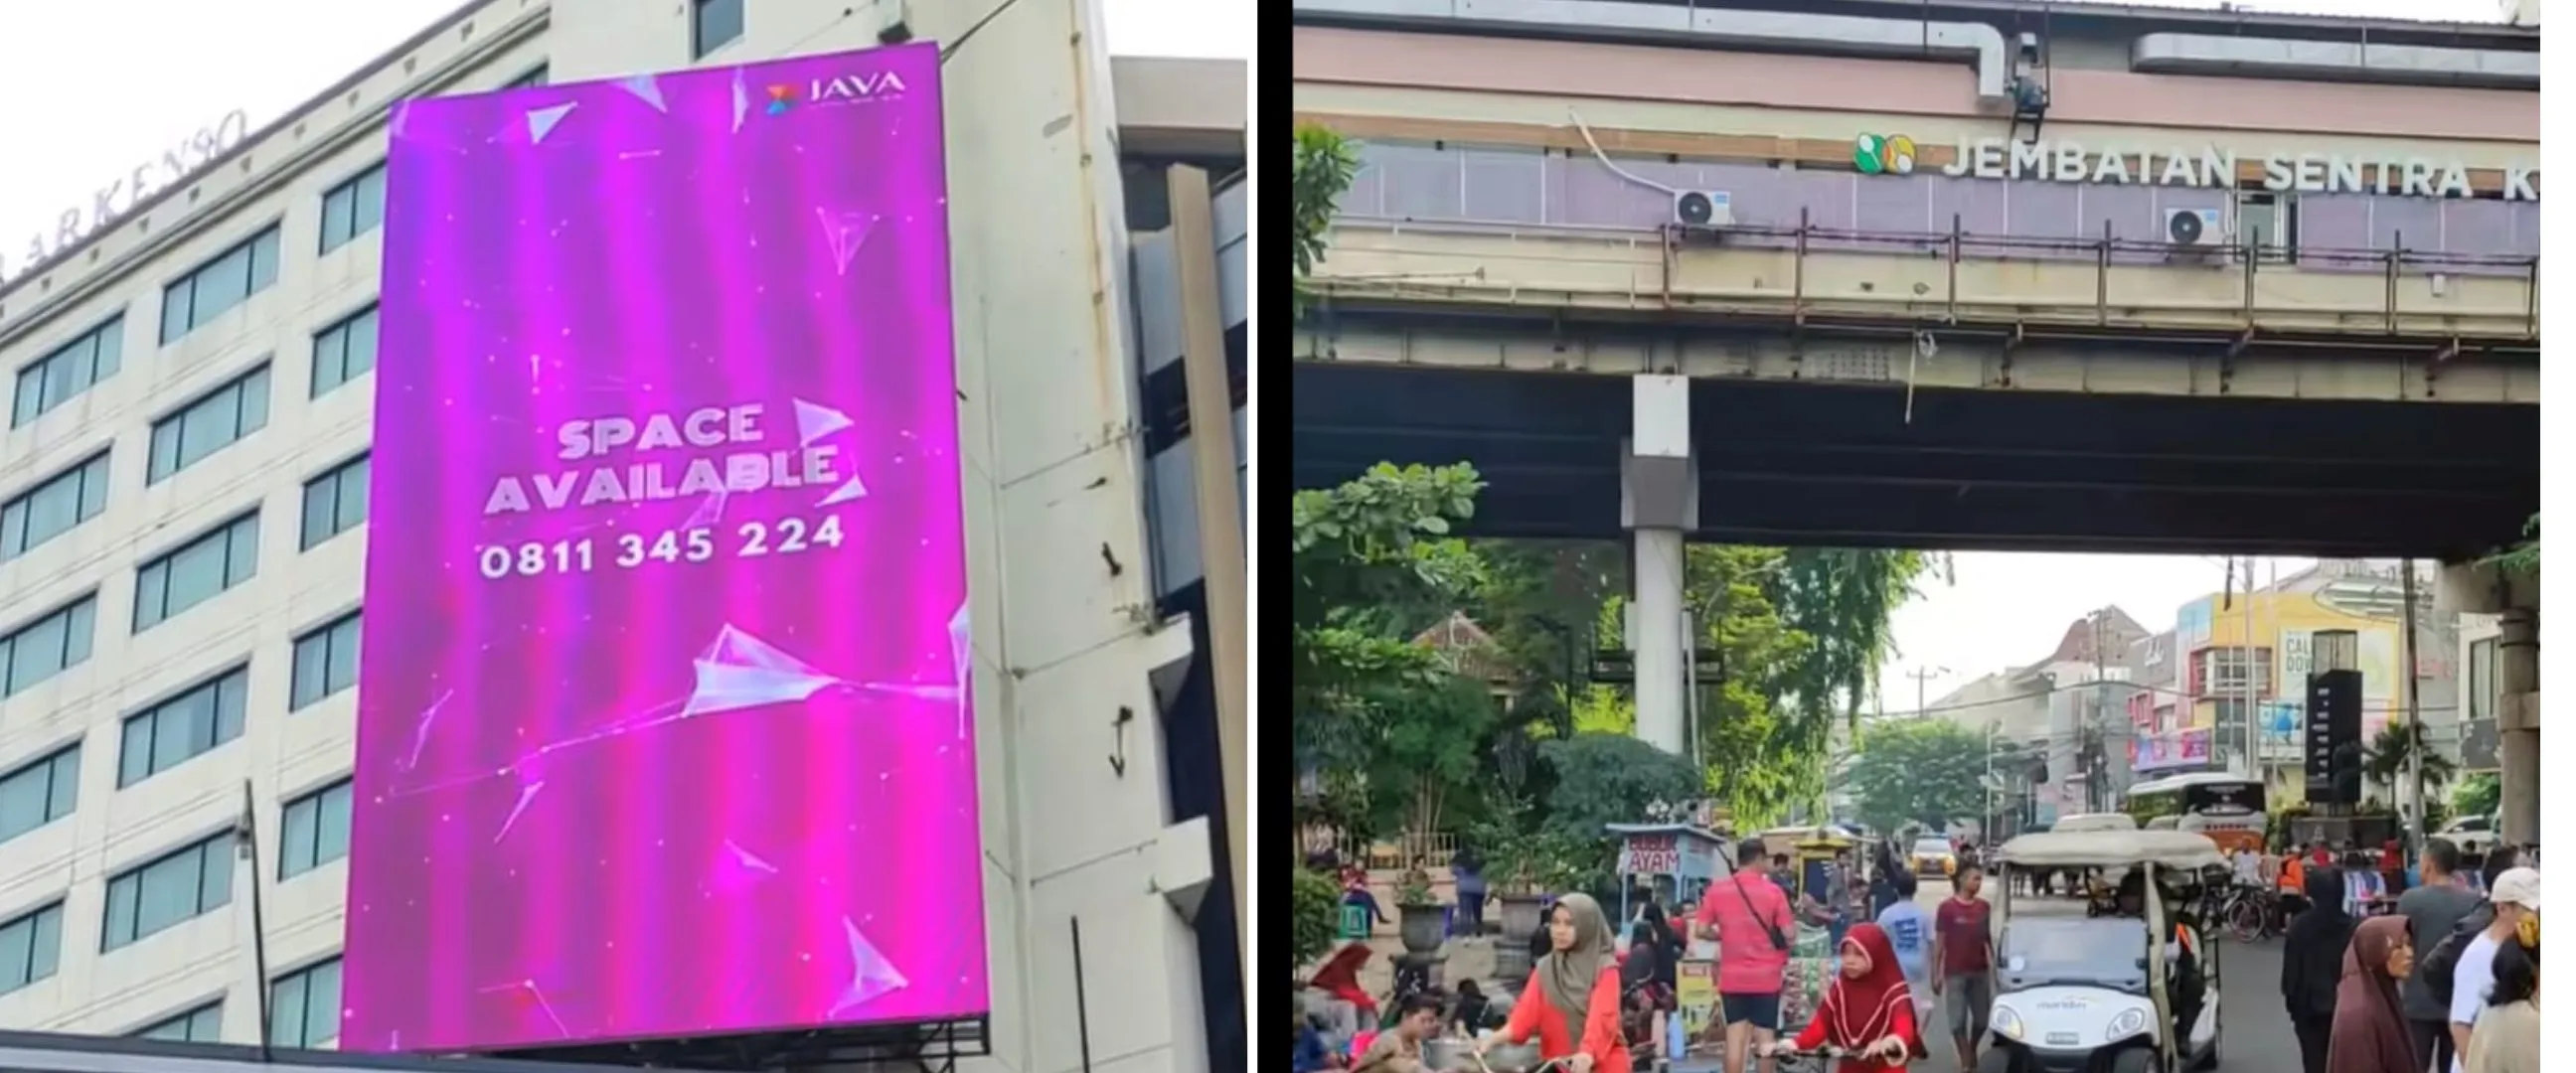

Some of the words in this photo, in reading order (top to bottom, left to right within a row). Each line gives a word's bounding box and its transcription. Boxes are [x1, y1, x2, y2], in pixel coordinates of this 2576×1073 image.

[810, 71, 906, 101] JAVA
[1942, 135, 2236, 187] JEMBATAN
[2262, 150, 2474, 198] SENTRA
[558, 402, 764, 460] SPACE
[483, 443, 840, 515] AVAILABLE
[480, 537, 593, 579] 0811
[615, 528, 714, 567] 345
[737, 514, 845, 556] 224
[1629, 850, 1681, 872] AYAM
